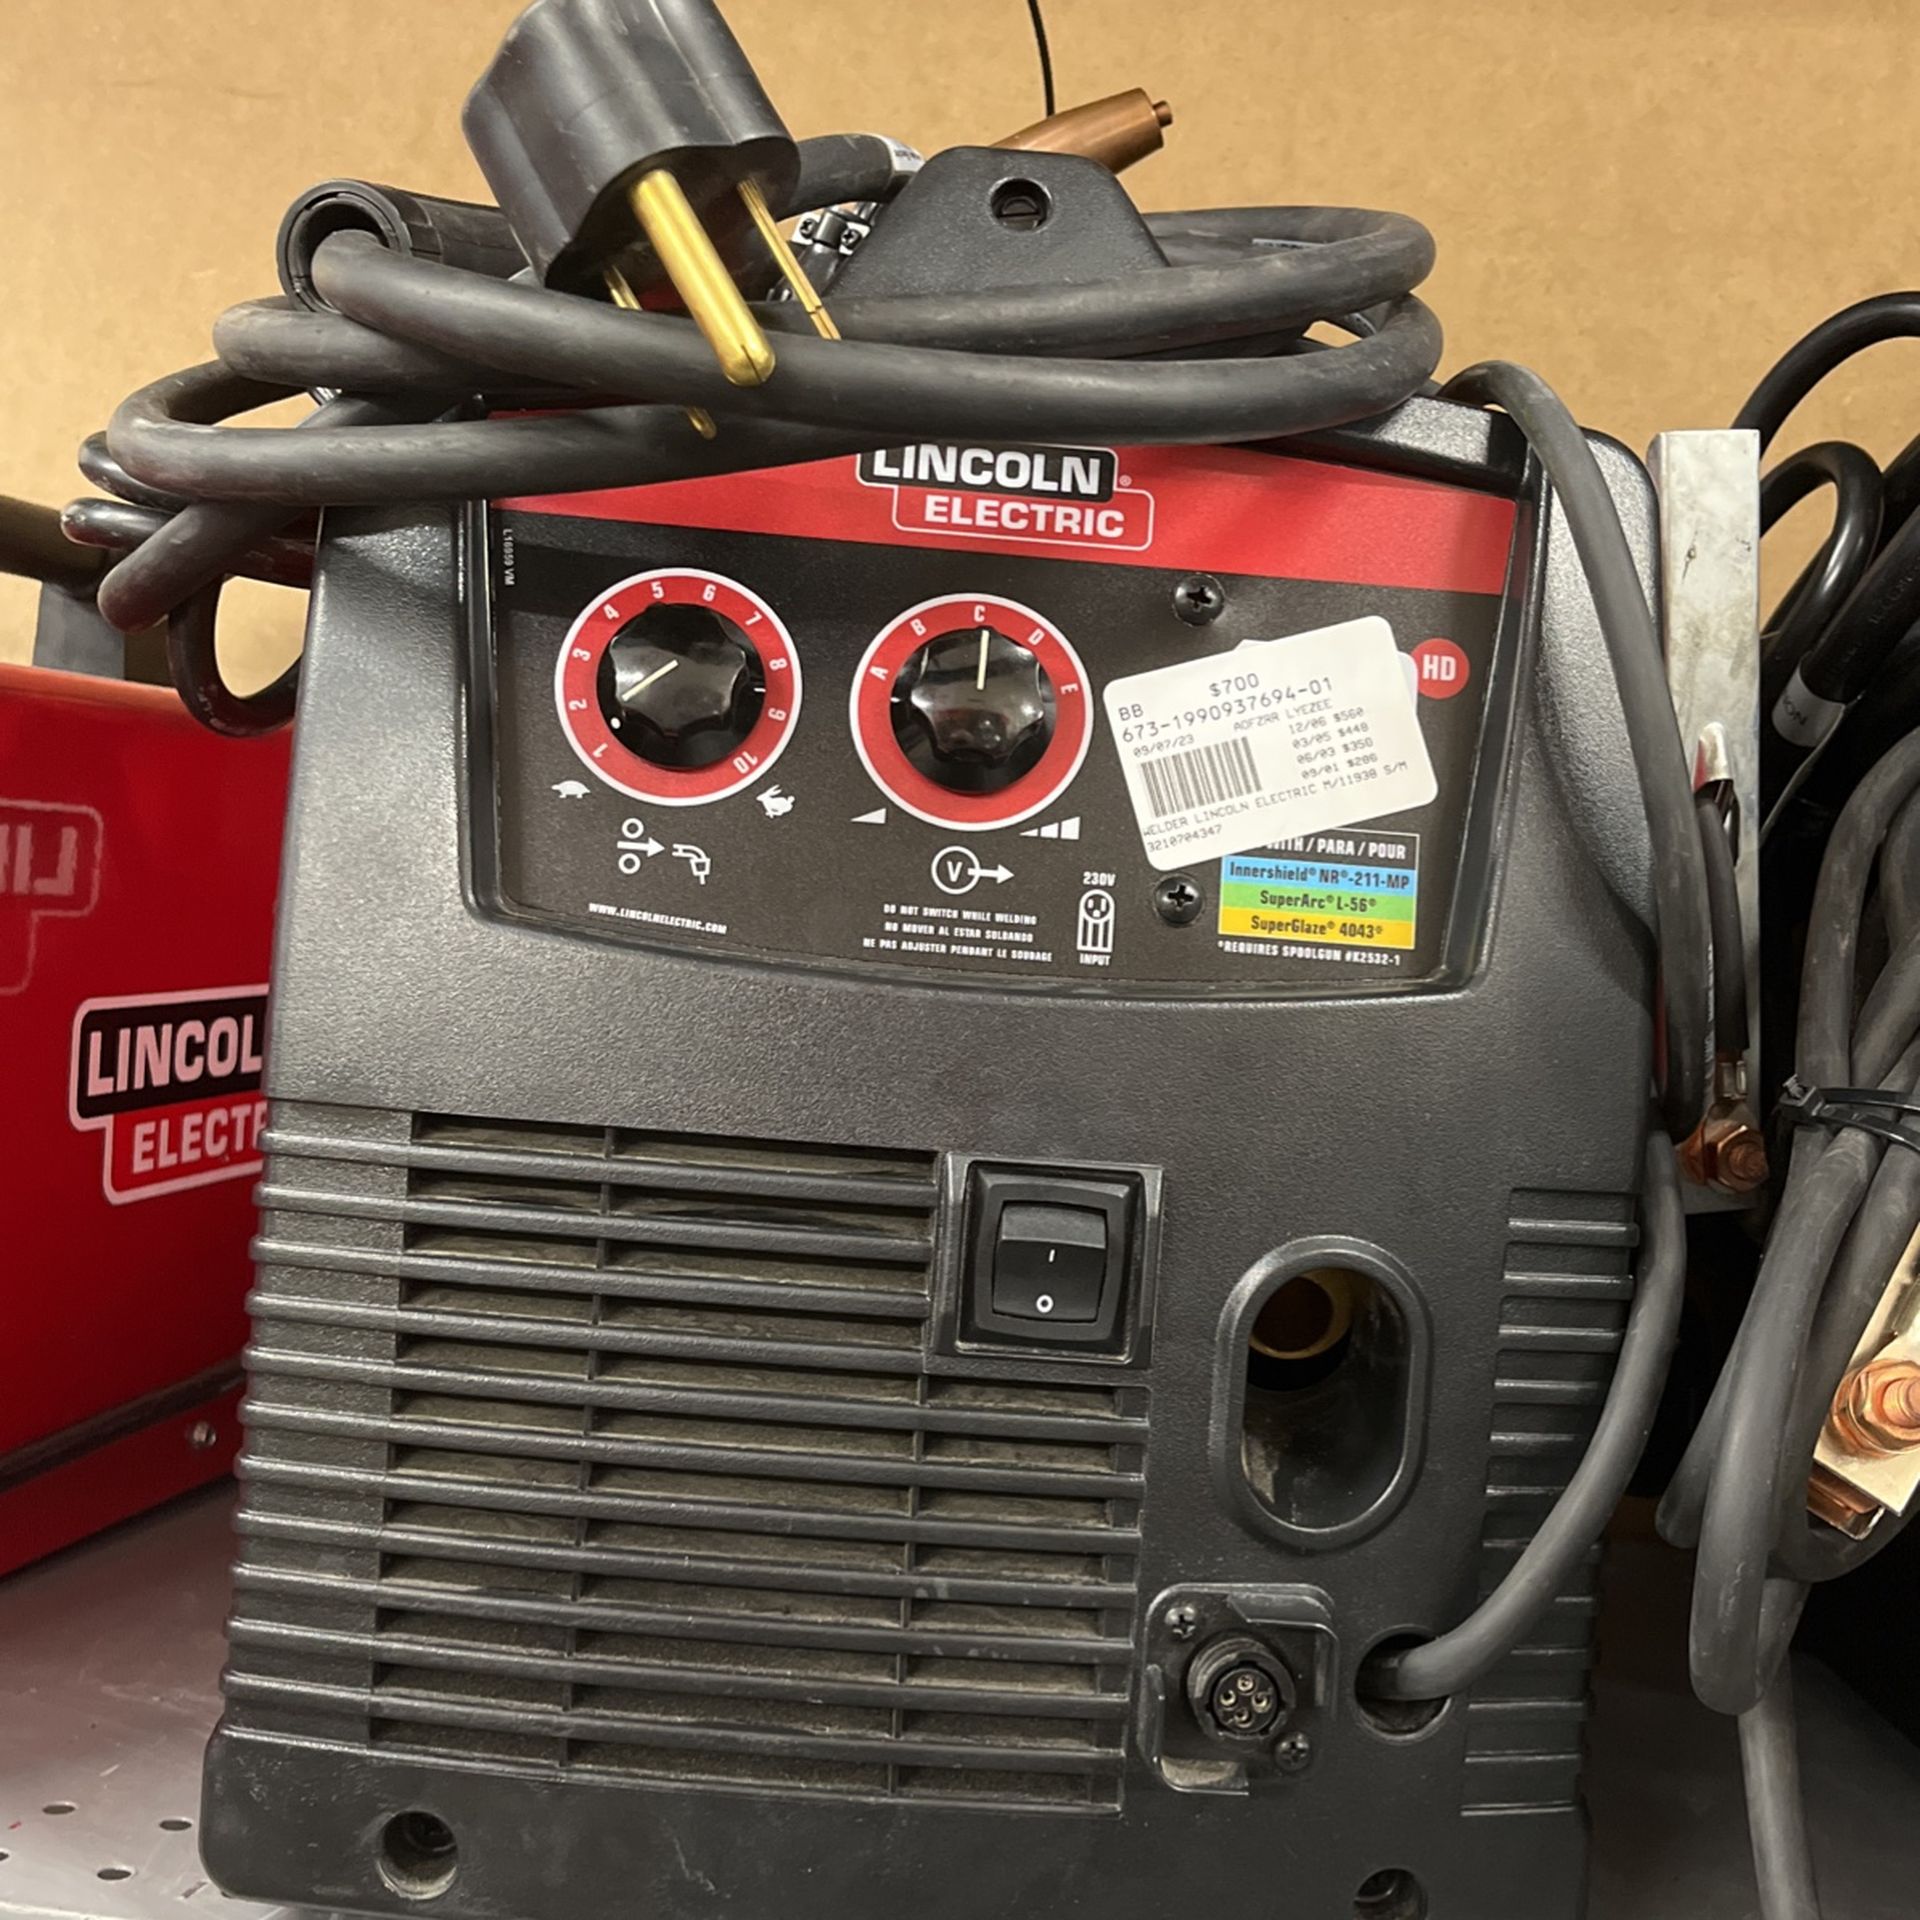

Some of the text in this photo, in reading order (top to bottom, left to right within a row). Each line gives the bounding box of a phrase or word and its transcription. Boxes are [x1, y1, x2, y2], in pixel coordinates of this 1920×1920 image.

[873, 443, 1101, 495] LINCOLN
[924, 494, 1126, 538] ELECTRIC
[869, 605, 1079, 695] A B C D E
[569, 581, 788, 774] 1 2 3 4 5 6 7 8 9 10
[1423, 654, 1456, 681] HD
[1209, 672, 1260, 698] $700
[1118, 703, 1144, 721] BB
[1122, 676, 1333, 743] 673-1990937694-01
[1289, 706, 1365, 734] 12/06 $560
[1292, 721, 1370, 749] 03/05 $448
[1296, 746, 1337, 765] 06/03
[1301, 762, 1340, 780] 09/01
[1143, 816, 1189, 837] WELDER
[1194, 801, 1250, 824] LINCOLN
[1254, 783, 1318, 808] ELECTRIC
[1383, 760, 1409, 776] S/M
[1317, 838, 1356, 856] PARA
[1368, 842, 1407, 860] POUR
[1083, 871, 1116, 887] 230V
[588, 902, 728, 935] WWW.LINCOLNELECTRIC.COM
[883, 903, 1038, 925] DO NOT SWITCH WHILE WELDING
[884, 921, 899, 932] NO
[902, 922, 935, 935] MOVER
[938, 925, 950, 937] AL
[953, 926, 982, 938] ESTAR
[862, 937, 876, 948] NE
[879, 938, 898, 950] PAS
[901, 940, 947, 954] ADJUSTER
[950, 944, 994, 957] PENDANT
[996, 948, 1008, 959] LE
[1079, 952, 1112, 967] INPUT
